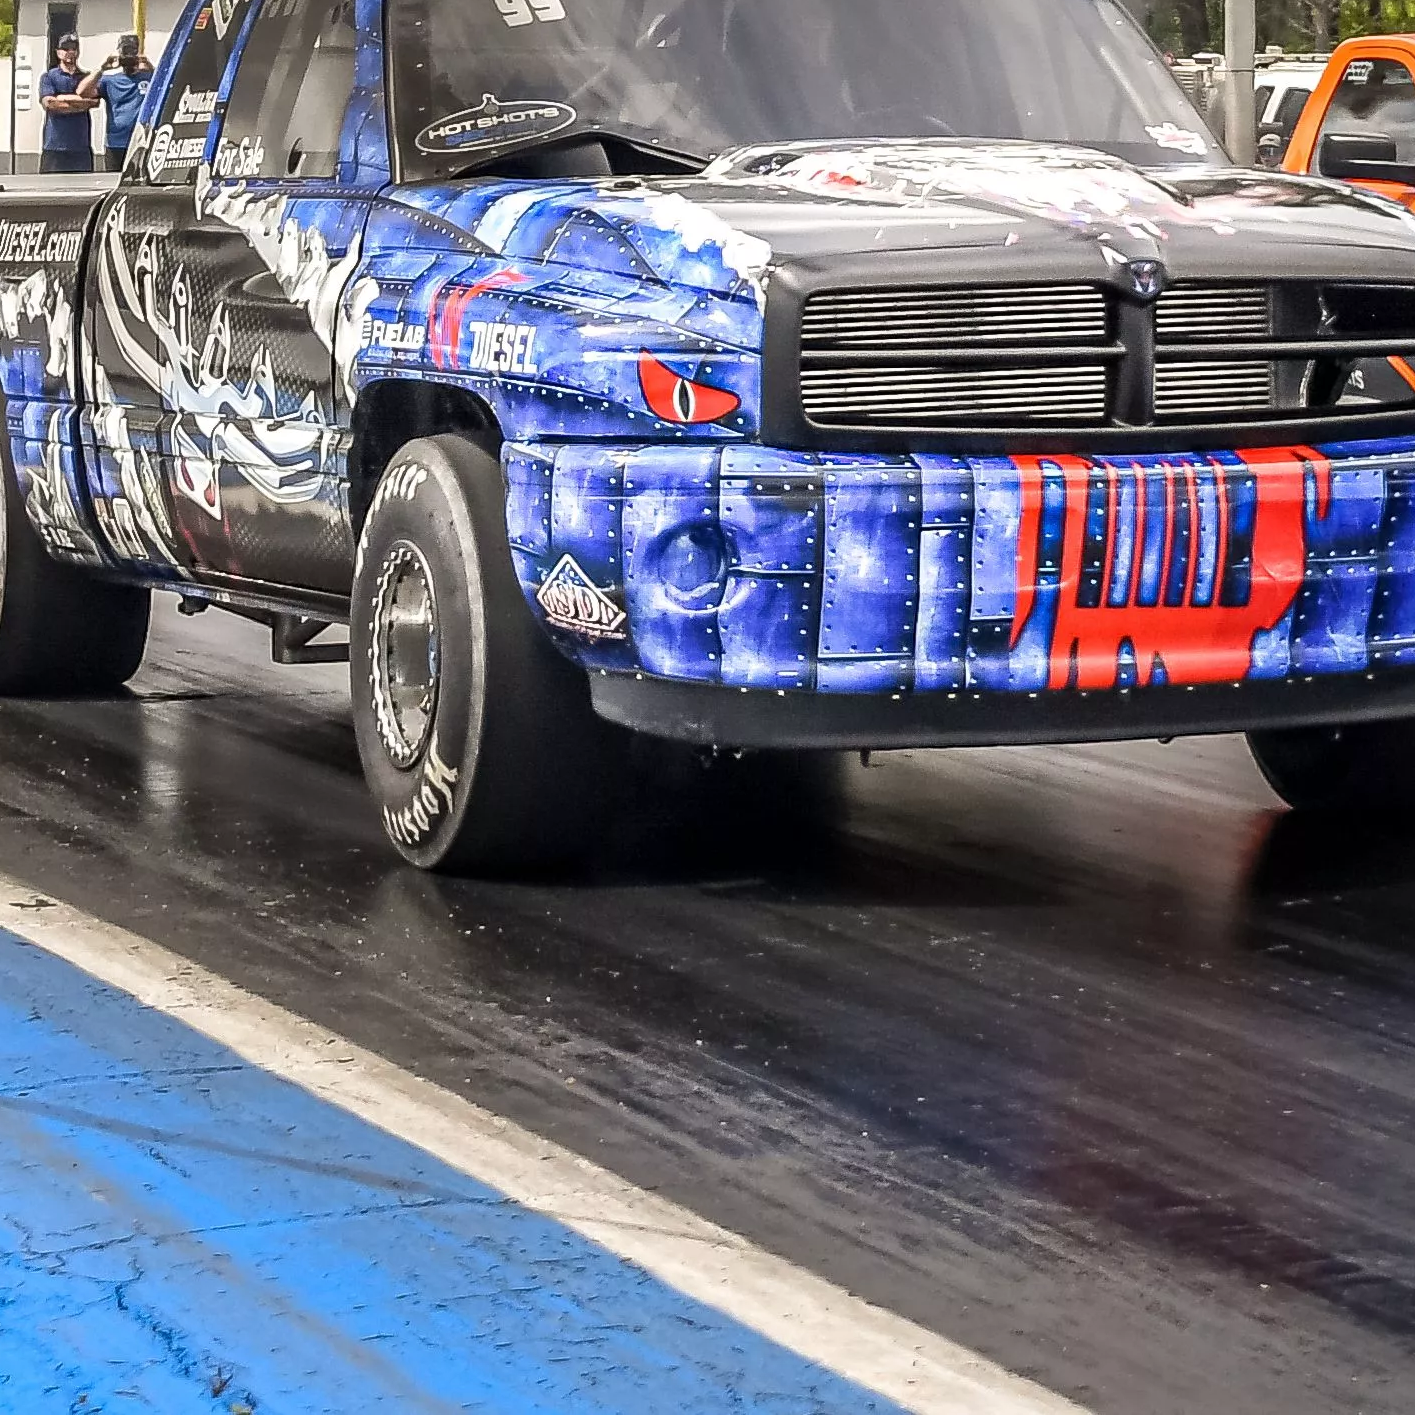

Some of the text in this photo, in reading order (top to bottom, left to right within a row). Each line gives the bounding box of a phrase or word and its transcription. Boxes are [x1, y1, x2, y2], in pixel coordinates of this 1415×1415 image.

[211, 135, 265, 176] For Sale
[371, 319, 426, 349] FUELAB
[468, 320, 538, 374] DIESEL
